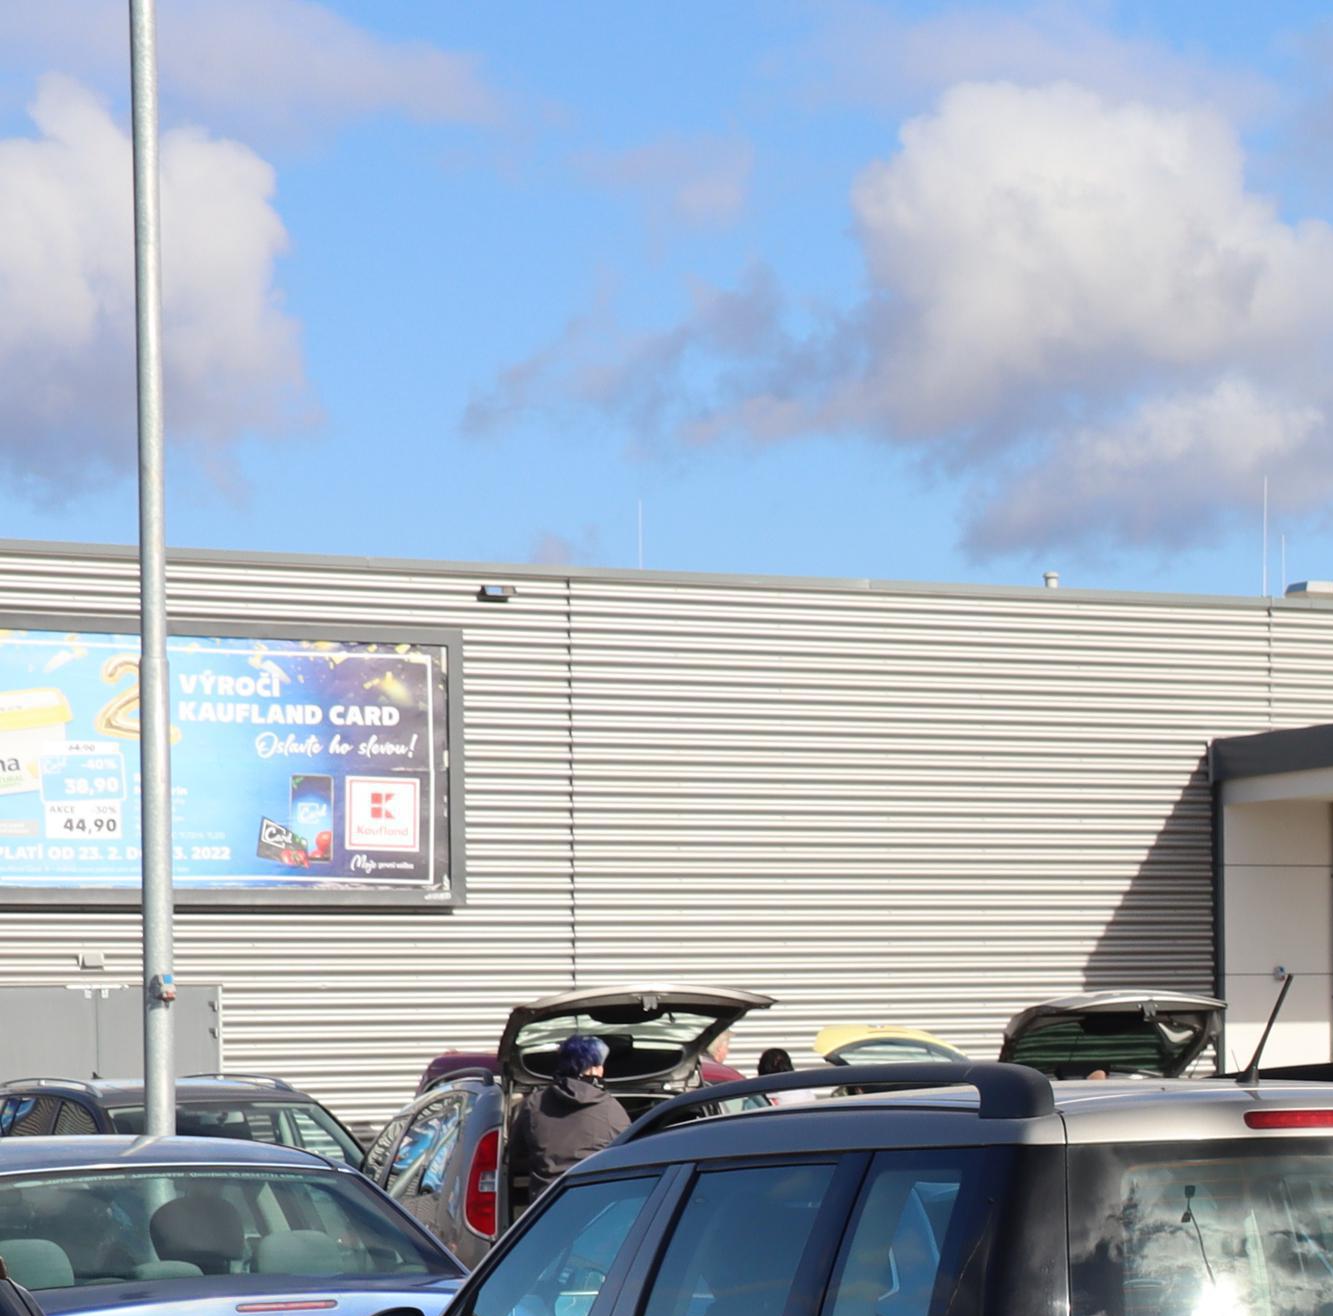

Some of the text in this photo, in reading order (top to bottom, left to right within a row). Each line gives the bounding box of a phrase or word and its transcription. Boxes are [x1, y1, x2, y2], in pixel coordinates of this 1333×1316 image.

[179, 702, 400, 726] KAUFLAND CARD
[256, 731, 418, 758] Oslavte ho slevou!
[64, 777, 119, 795] 38,90
[64, 818, 117, 834] 44,90
[356, 825, 408, 837] Kaufland
[48, 846, 75, 860] OD
[126, 846, 141, 860] D
[191, 846, 231, 860] 2022
